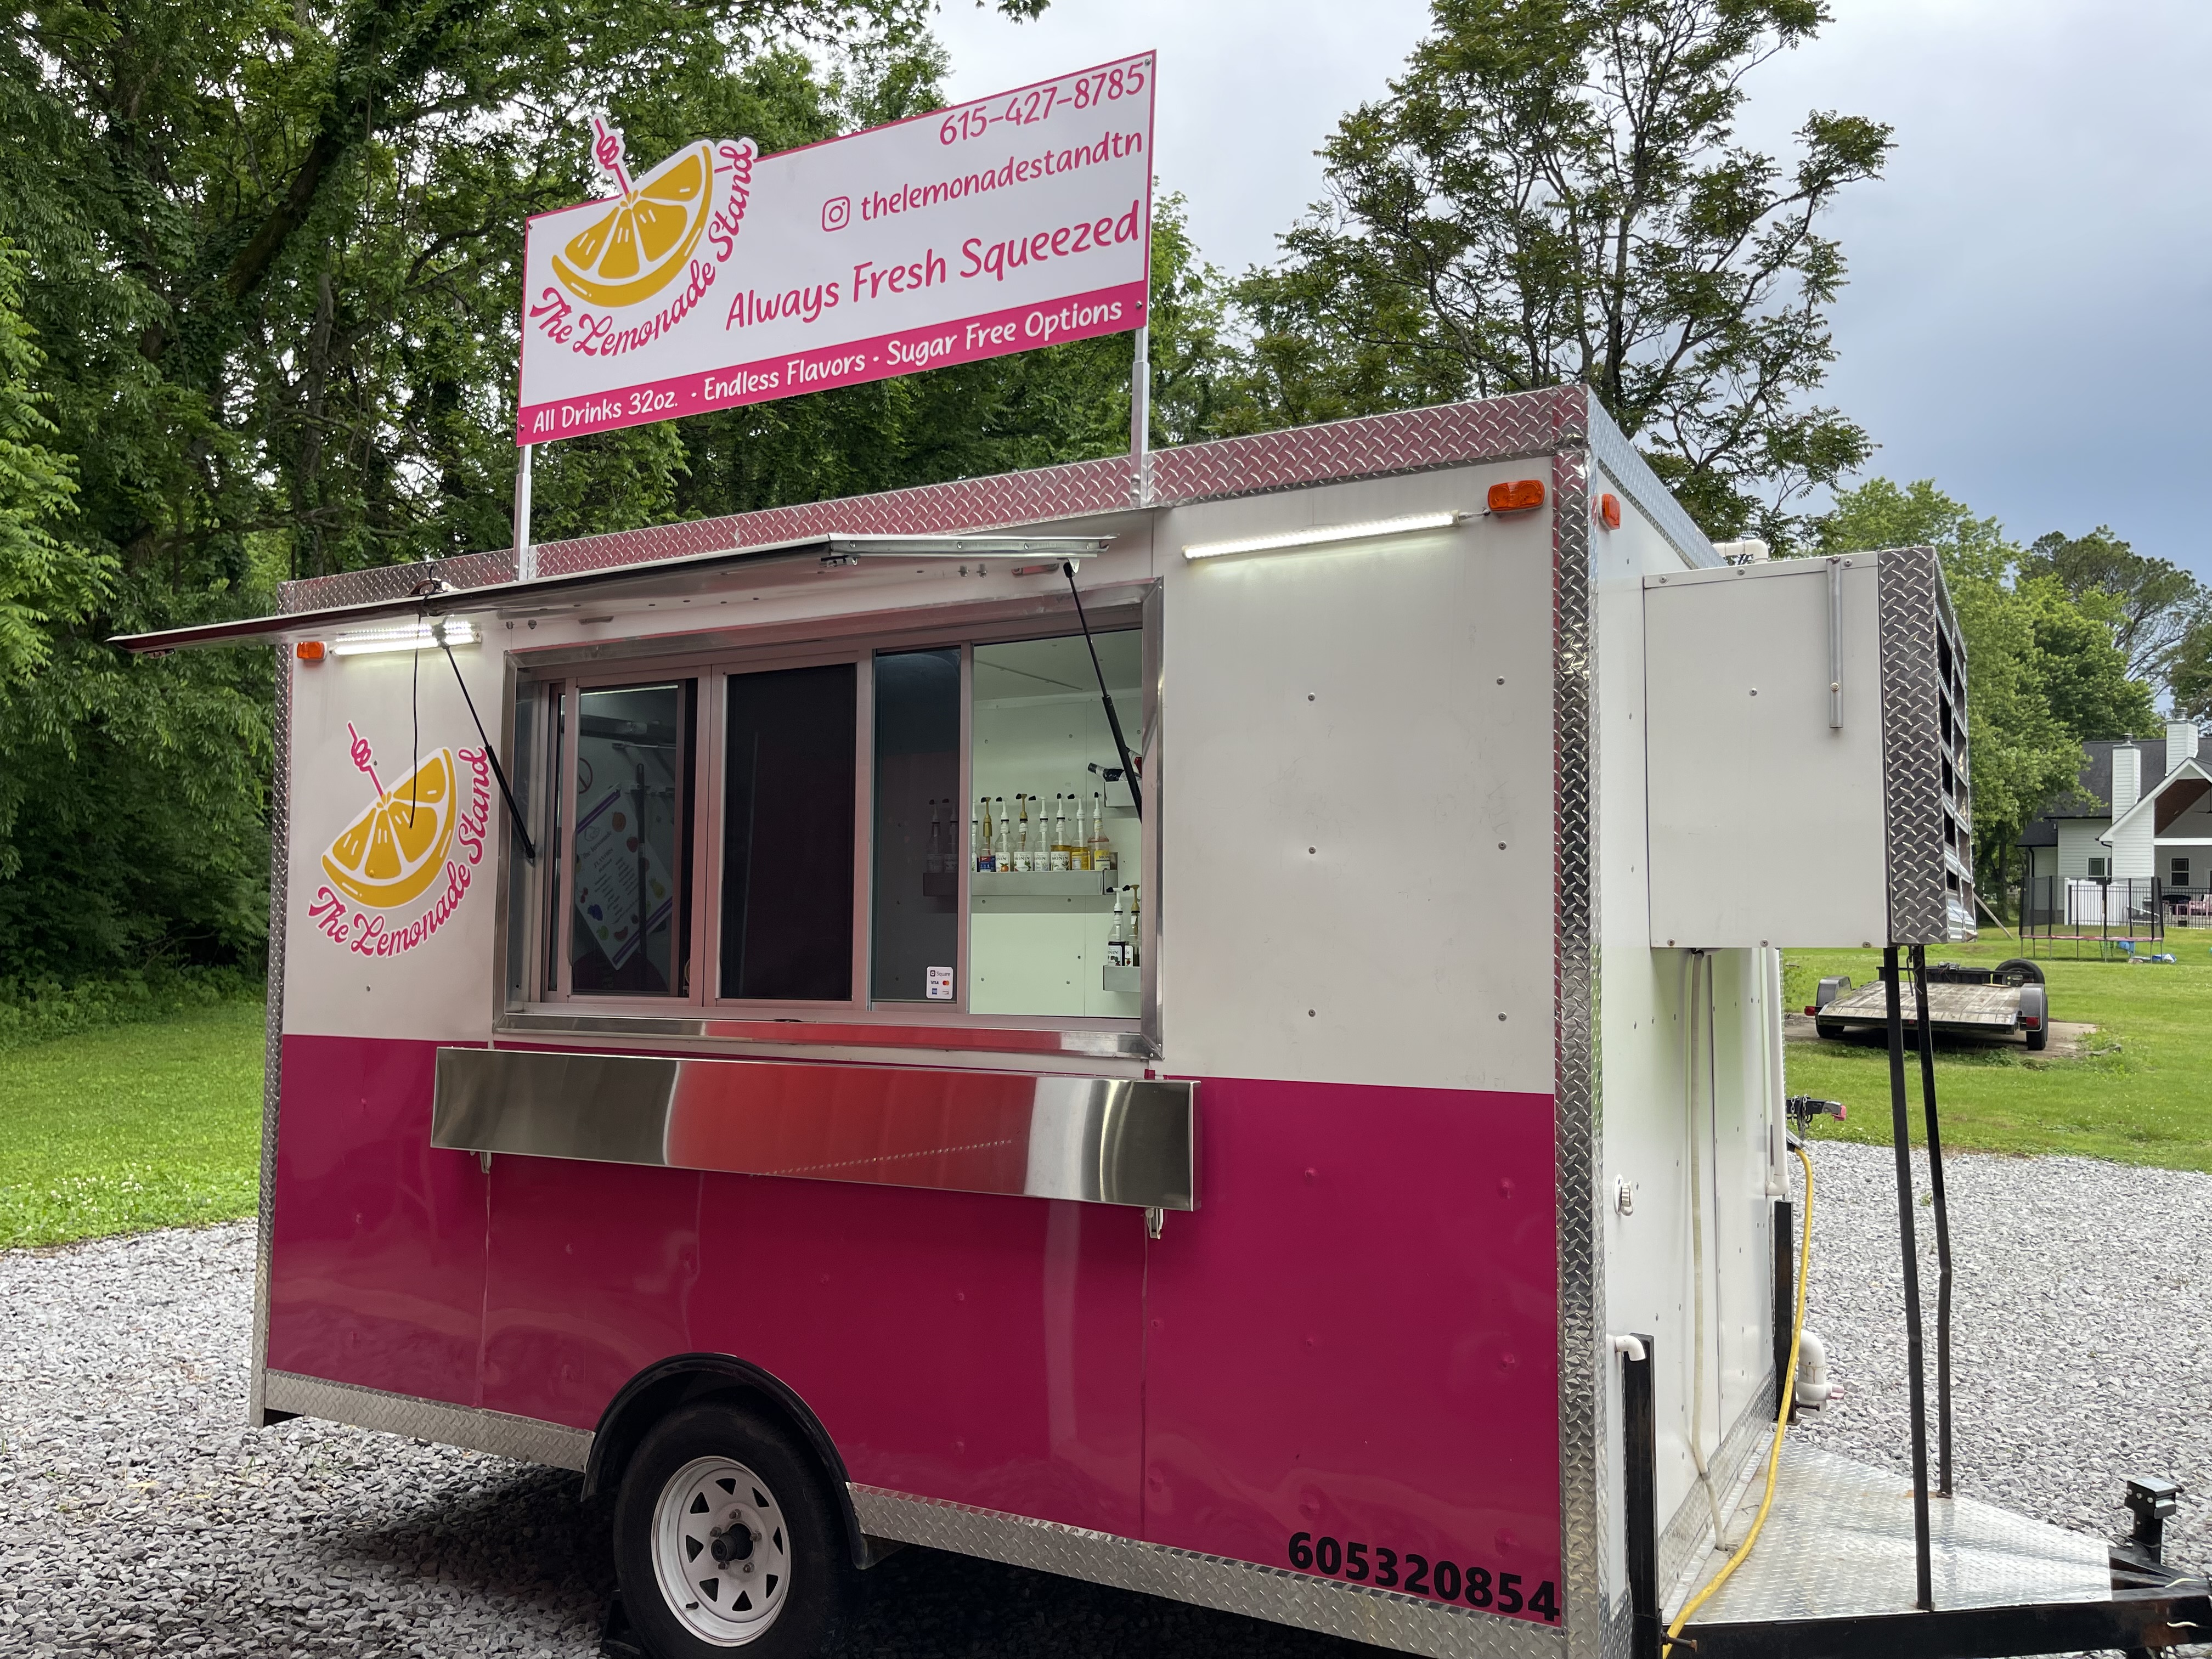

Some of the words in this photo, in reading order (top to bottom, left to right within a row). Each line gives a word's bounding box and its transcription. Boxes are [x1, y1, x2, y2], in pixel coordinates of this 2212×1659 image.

[940, 63, 1144, 145] 615-427-8785
[861, 132, 1142, 221] thelemonadestandtn
[529, 287, 573, 345] The
[572, 260, 715, 358] Lemonade
[708, 144, 753, 262] Stand
[726, 282, 839, 330] Always
[853, 249, 946, 302] Fresh
[960, 200, 1139, 281] Squeezed
[533, 409, 555, 433] All
[561, 398, 622, 428] Drinks
[628, 390, 679, 415] 32oz.
[704, 371, 779, 400] Endless
[787, 354, 865, 385] Flavors
[887, 335, 957, 366] Sugar
[966, 323, 1016, 350] Free
[1025, 302, 1122, 342] Options
[308, 886, 349, 944] The
[351, 861, 471, 956] Lemonade
[458, 747, 491, 865] Stand
[1288, 1532, 1560, 1622] 605320854
